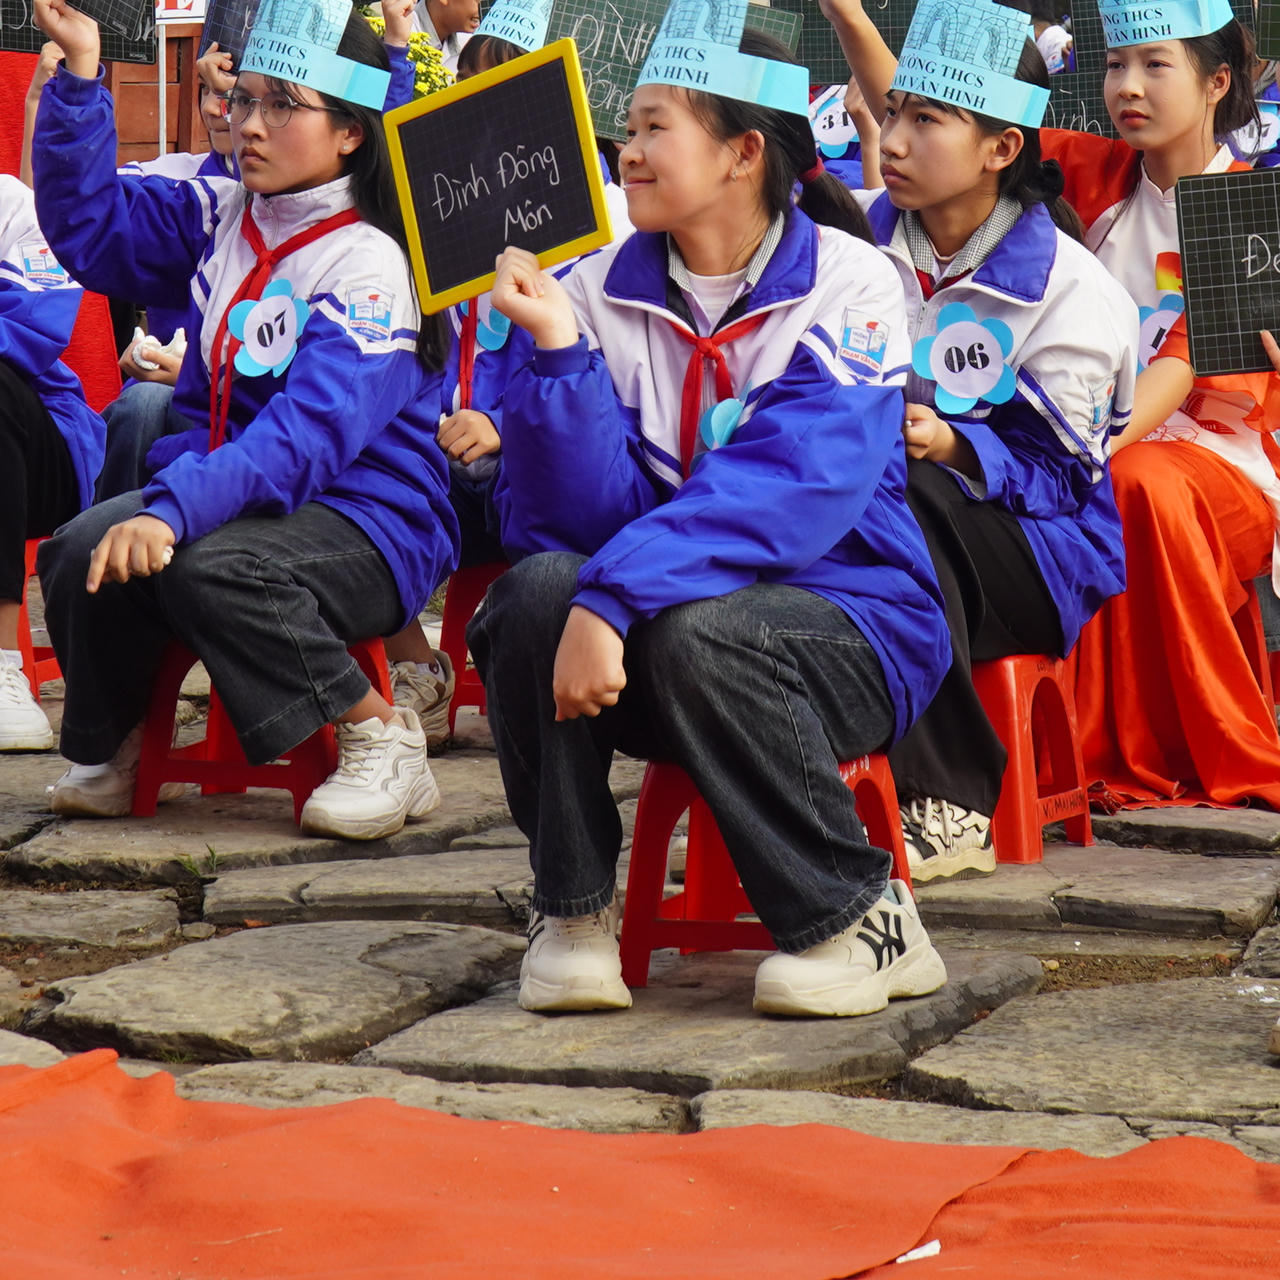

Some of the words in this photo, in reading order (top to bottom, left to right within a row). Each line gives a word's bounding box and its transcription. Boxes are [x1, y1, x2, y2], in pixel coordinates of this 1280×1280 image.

[1122, 7, 1163, 24] THCS
[1132, 24, 1172, 40] HINH
[269, 40, 308, 60] THCS
[664, 45, 707, 63] THCS
[268, 58, 309, 80] HINH
[663, 65, 710, 85] HINH
[941, 64, 985, 89] THCS
[910, 75, 940, 95] VĂN
[942, 86, 987, 110] HINH
[431, 162, 491, 222] Đình
[496, 144, 560, 186] Đông
[504, 199, 553, 242] Môn
[256, 308, 287, 348] 07
[943, 342, 990, 374] 06
